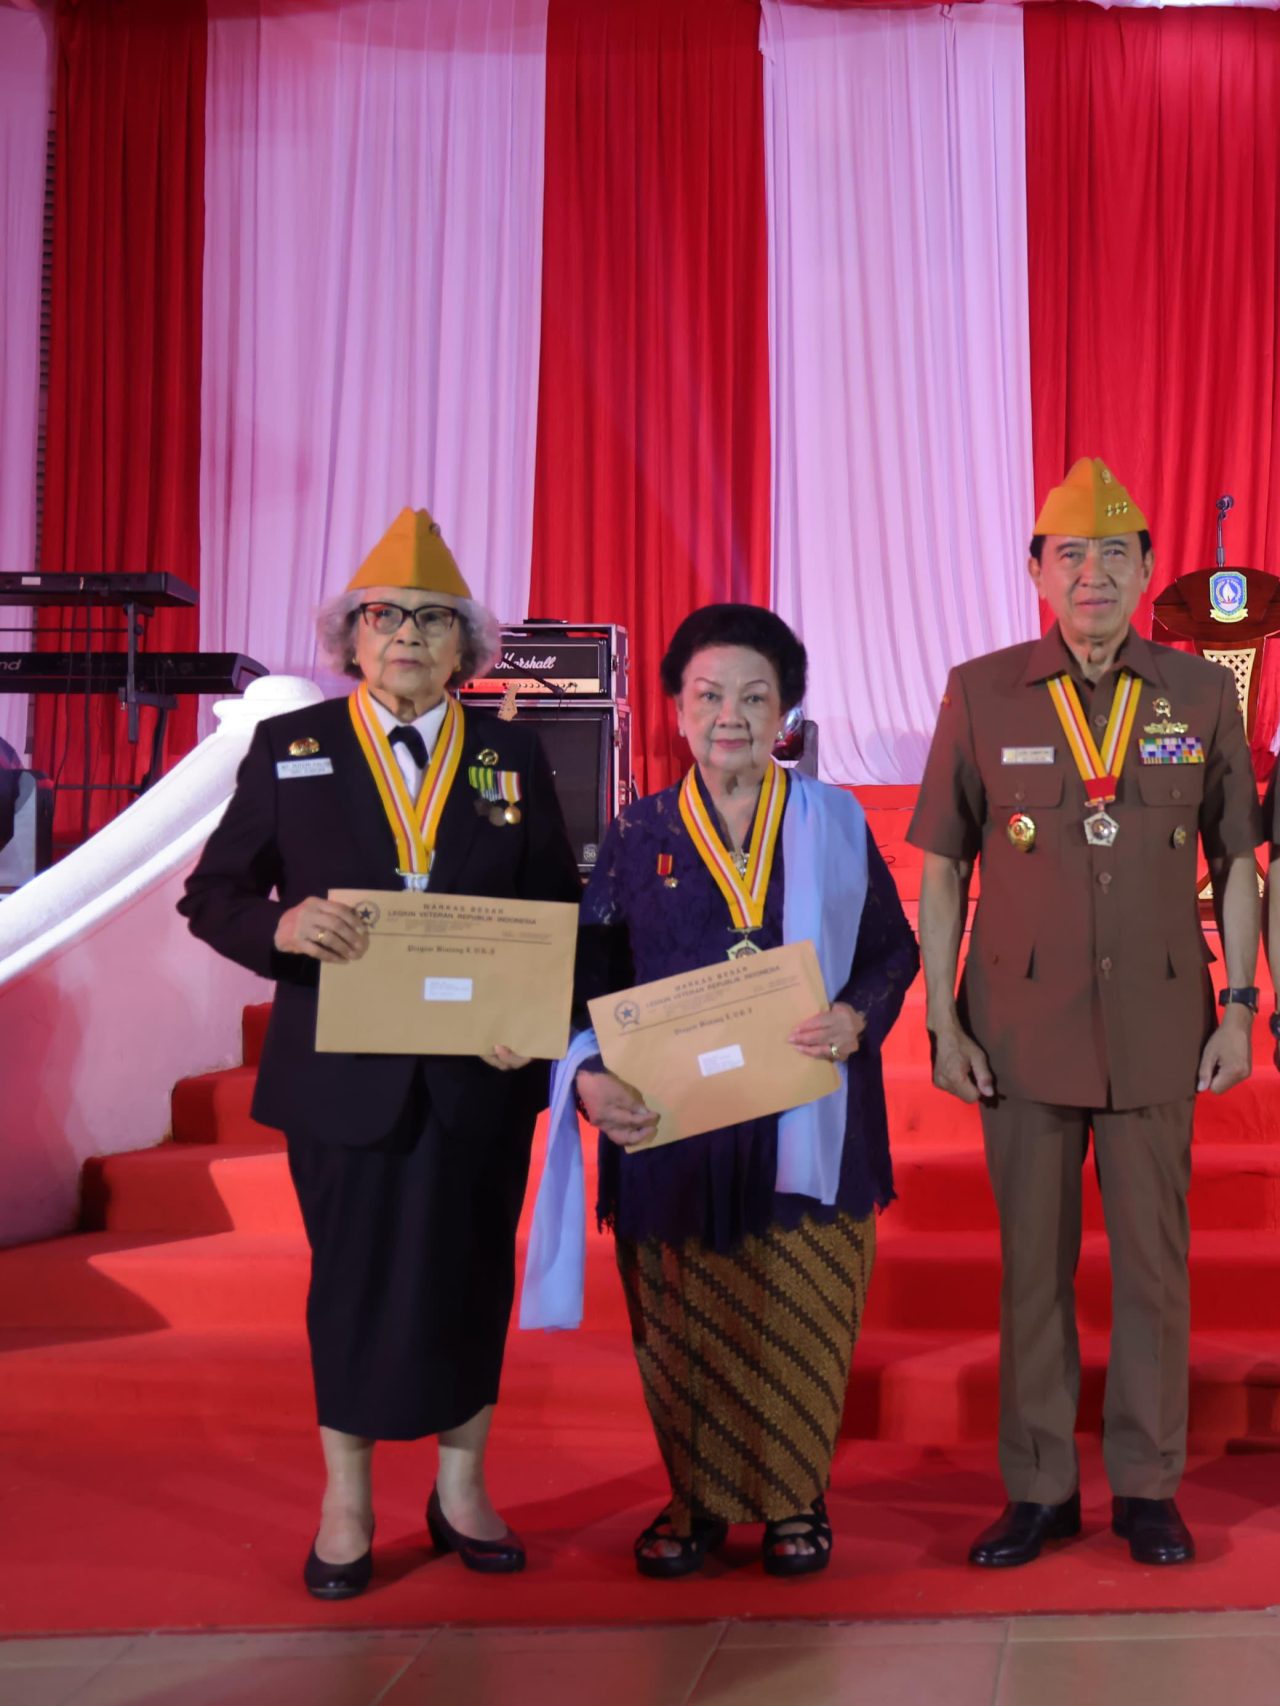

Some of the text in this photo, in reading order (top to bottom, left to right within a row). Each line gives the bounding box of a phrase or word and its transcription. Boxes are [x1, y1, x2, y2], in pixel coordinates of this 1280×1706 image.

[494, 652, 557, 670] Mrshall
[423, 903, 466, 912] MARKAS
[419, 912, 454, 920] VETERAN
[457, 914, 493, 922] REPUBLIK
[496, 917, 537, 925] INDONESIA
